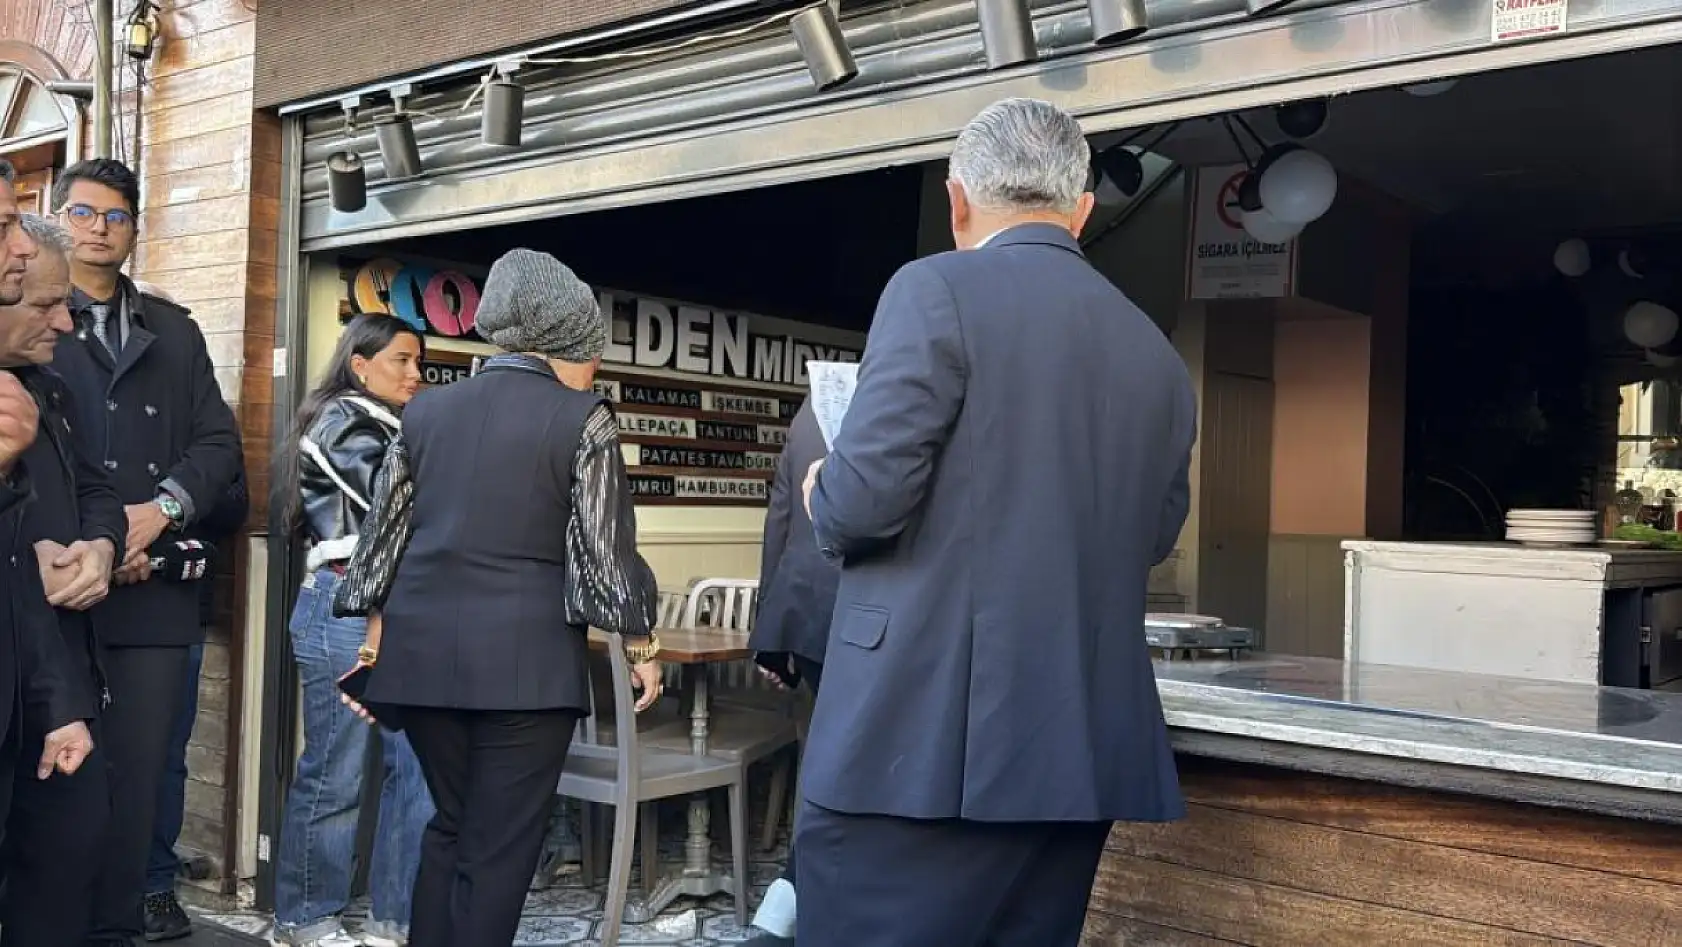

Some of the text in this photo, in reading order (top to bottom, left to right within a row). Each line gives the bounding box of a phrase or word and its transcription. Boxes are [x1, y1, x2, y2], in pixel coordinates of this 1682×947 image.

[1198, 241, 1239, 259] SİGARA
[625, 385, 699, 407] KALAMAR
[641, 449, 706, 466] PATATES
[710, 452, 744, 468] TAVA
[677, 479, 765, 496] HAMBURGER
